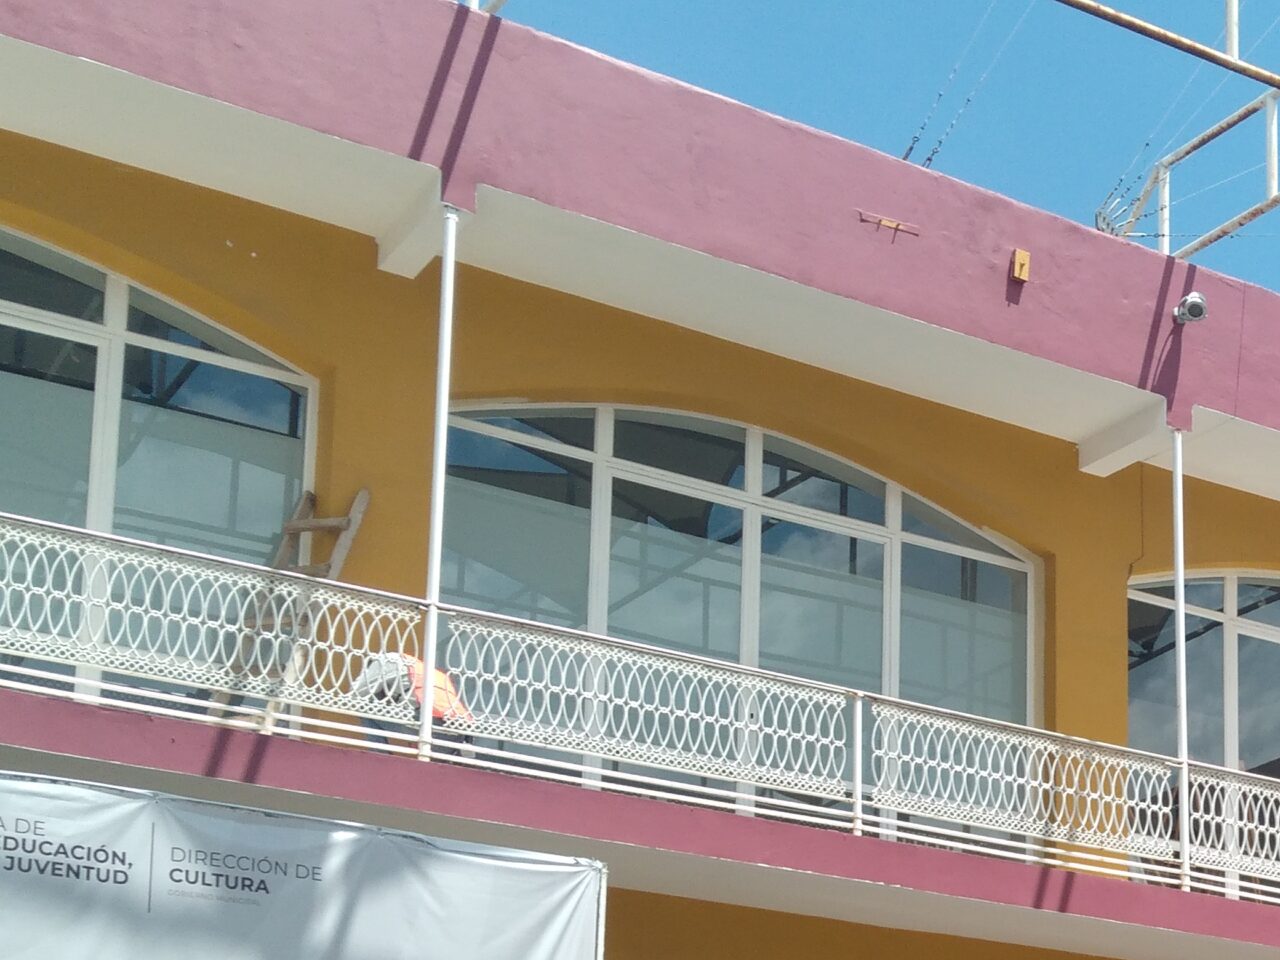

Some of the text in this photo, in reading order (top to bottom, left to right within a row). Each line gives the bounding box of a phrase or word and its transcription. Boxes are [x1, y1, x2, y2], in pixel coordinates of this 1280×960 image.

[15, 817, 46, 837] DE
[0, 835, 133, 869] DUCACIÓN,
[170, 847, 323, 882] DIRECCIÓN DE
[3, 855, 129, 885] JUVENTUD
[168, 867, 270, 895] CULTURA
